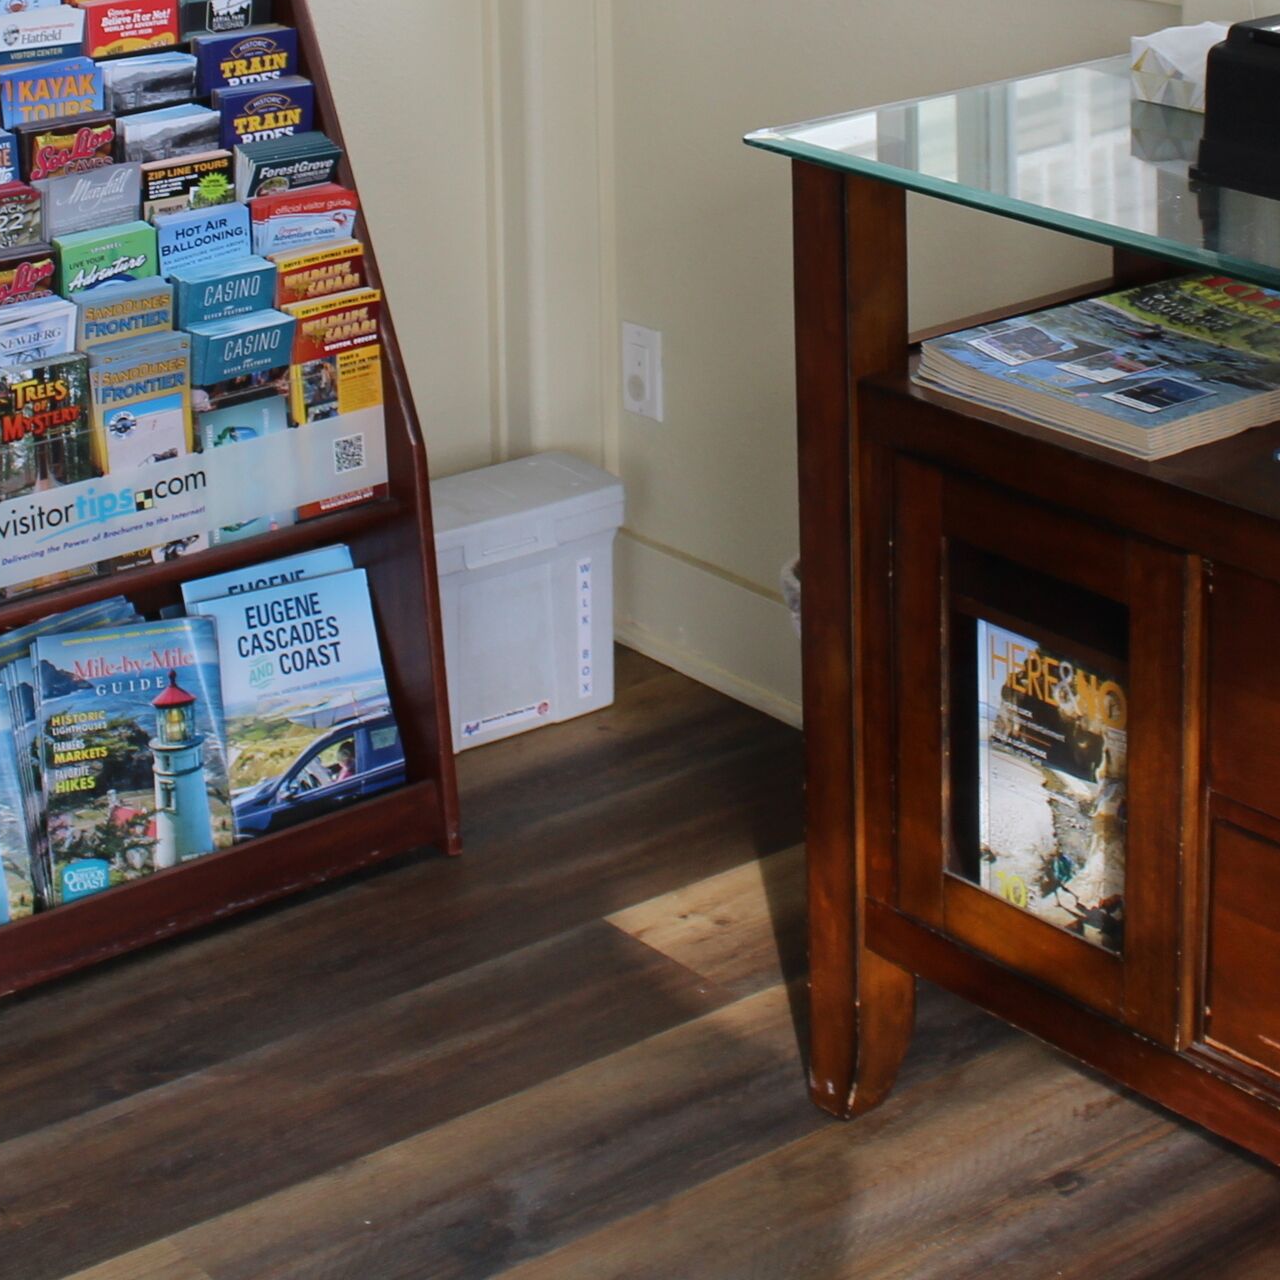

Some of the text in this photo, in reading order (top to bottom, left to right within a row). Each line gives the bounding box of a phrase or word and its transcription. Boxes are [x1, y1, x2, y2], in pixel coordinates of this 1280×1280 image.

[21, 28, 62, 45] Hatfield
[220, 52, 288, 78] TRAIN
[19, 73, 96, 102] KAYAK
[233, 108, 302, 135] TRAIN
[147, 159, 229, 181] ZIP LINE TOURS
[161, 227, 244, 257] BALLOONING
[175, 218, 228, 241] HOT AIR
[69, 254, 146, 291] Adventure
[204, 275, 261, 307] CASINO
[84, 309, 170, 340] FRONTIER
[224, 329, 281, 361] CASINO
[10, 378, 68, 410] TREES
[101, 372, 185, 404] FRONTIER
[33, 400, 48, 411] OF
[1, 405, 80, 444] MYSTERY
[1, 506, 205, 566] Delivering the Power of Brochures to the Internet!
[245, 593, 322, 630] EUGENE
[238, 616, 339, 658] CASCADES
[73, 647, 193, 681] Mile-by-Mile
[249, 642, 341, 684] AND COAST
[96, 676, 165, 697] GUIDE
[51, 710, 106, 727] HISTORIC
[54, 747, 108, 765] MARKETS
[55, 776, 96, 794] HIKES
